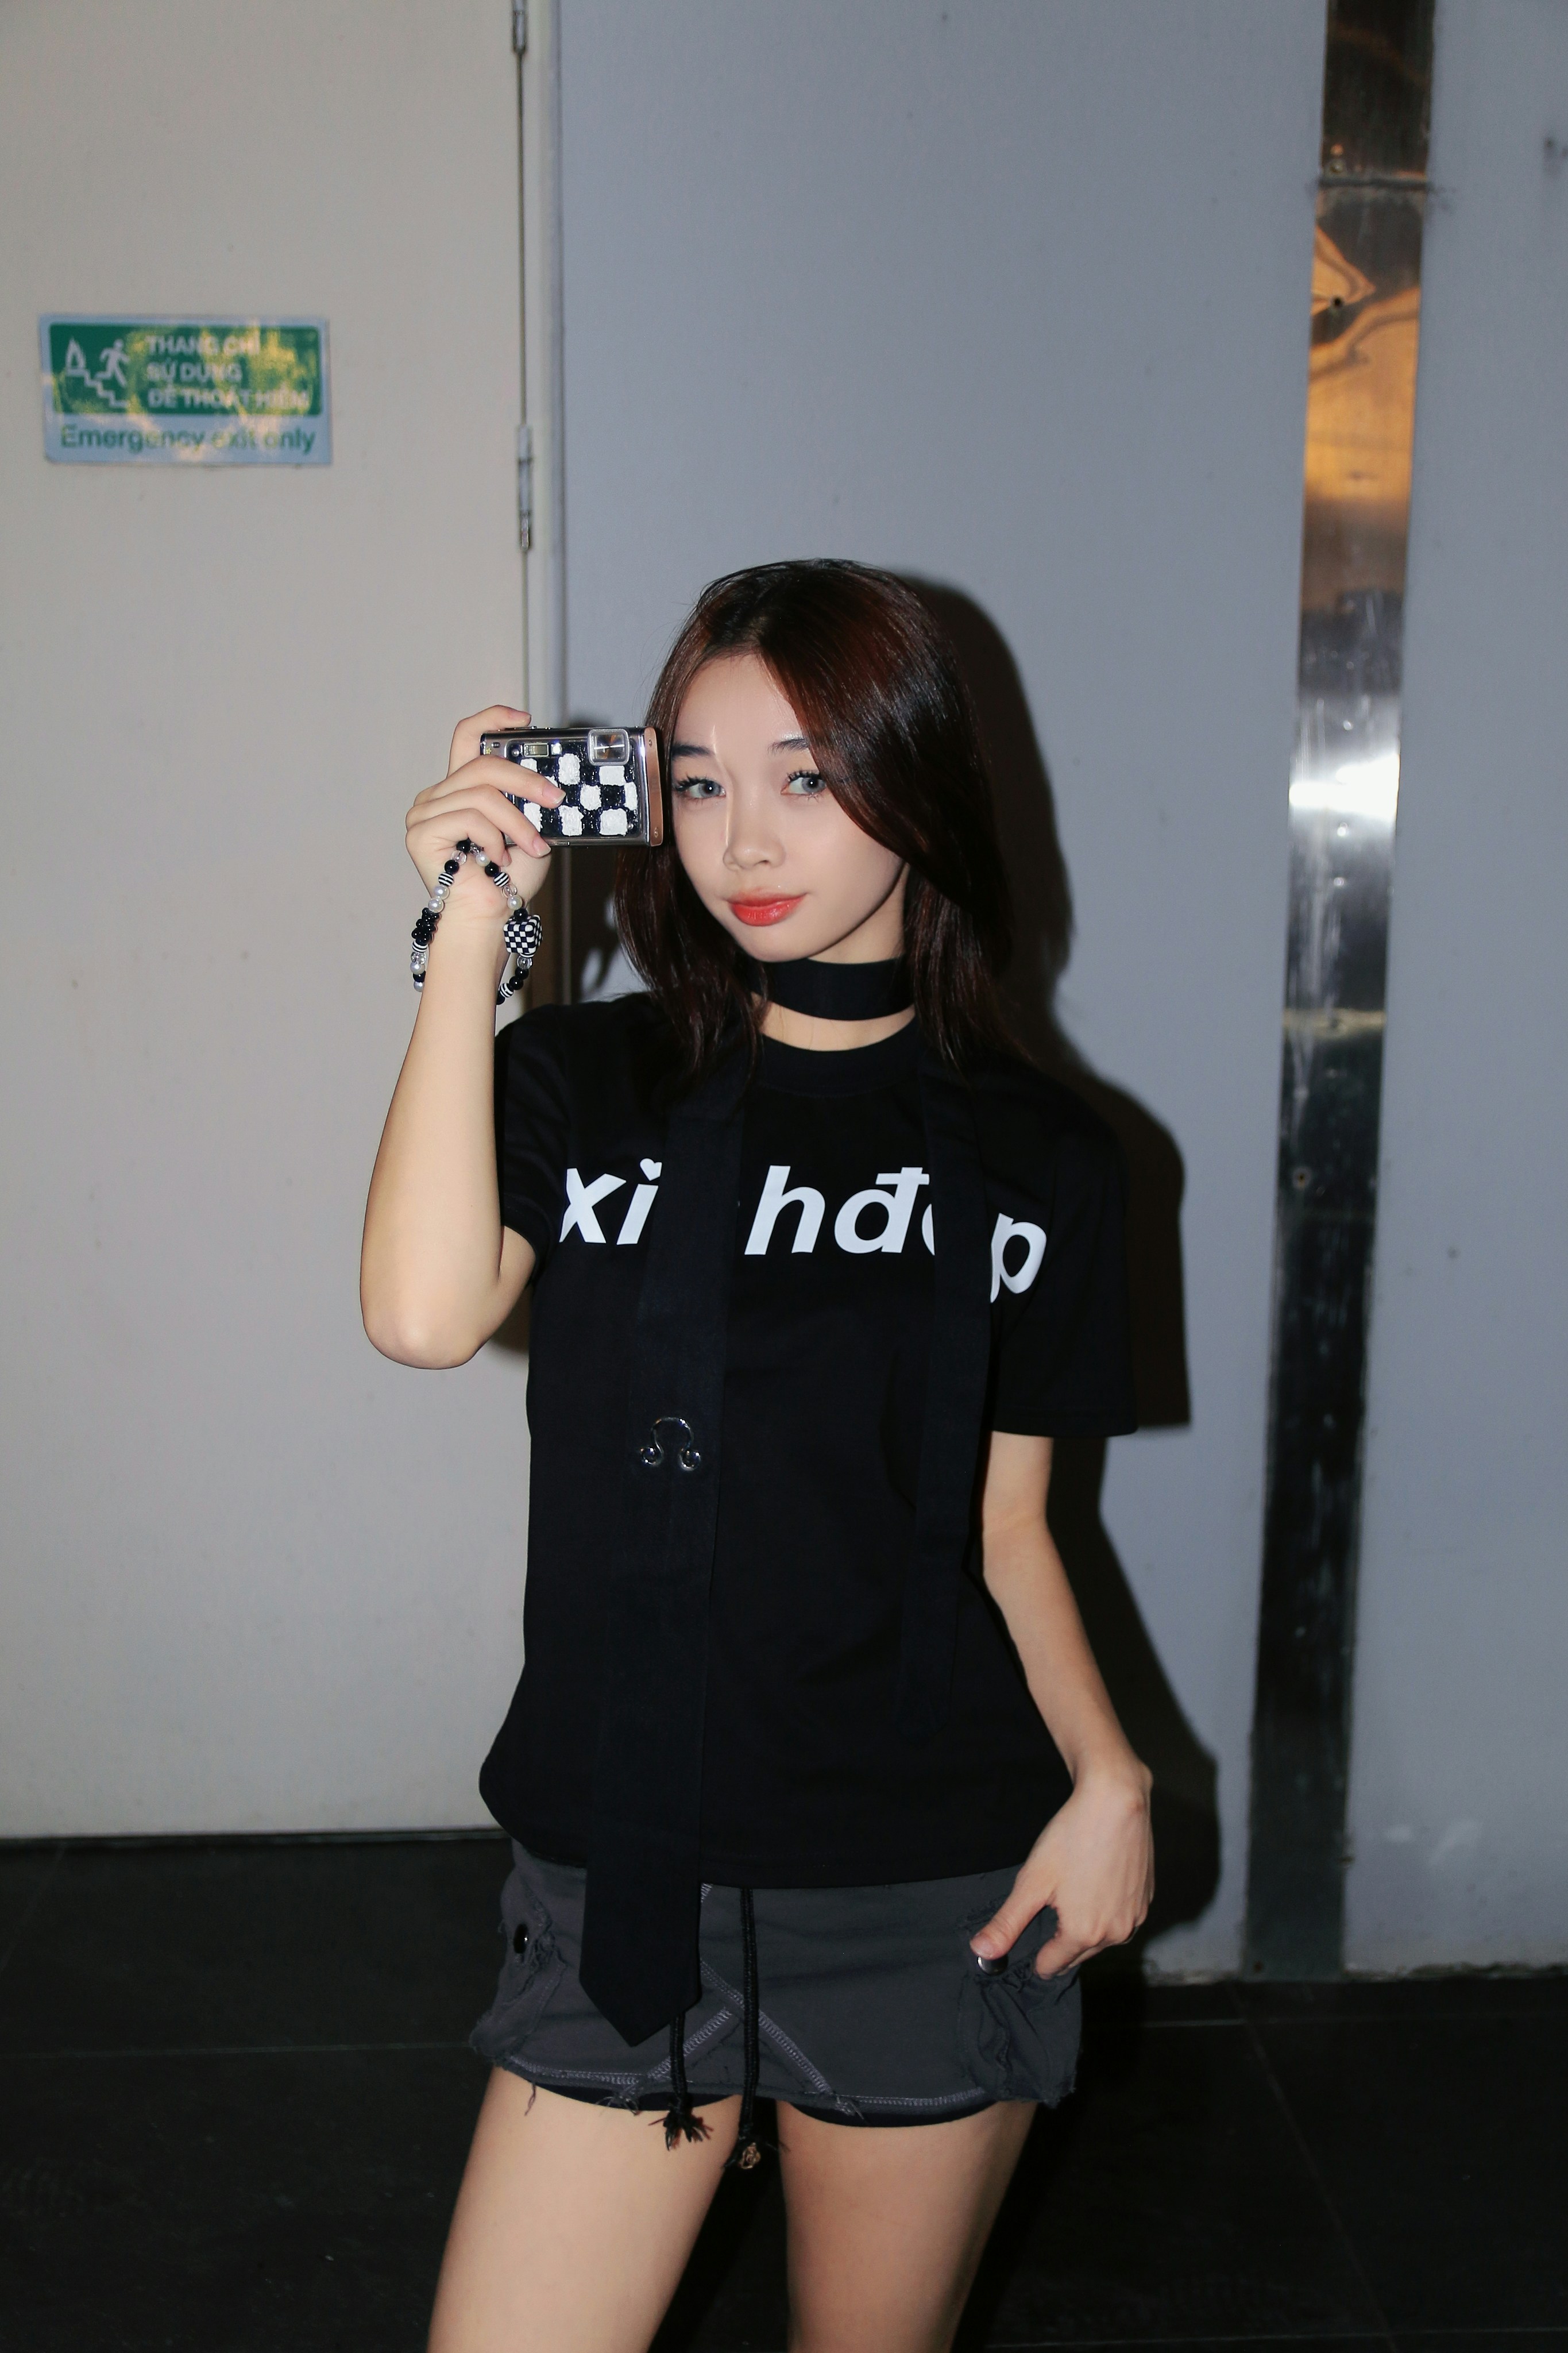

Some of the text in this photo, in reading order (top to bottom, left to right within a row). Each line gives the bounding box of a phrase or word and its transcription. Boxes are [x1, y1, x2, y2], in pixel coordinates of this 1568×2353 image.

[144, 335, 219, 356] THANG
[60, 423, 316, 454] Emergency exit only
